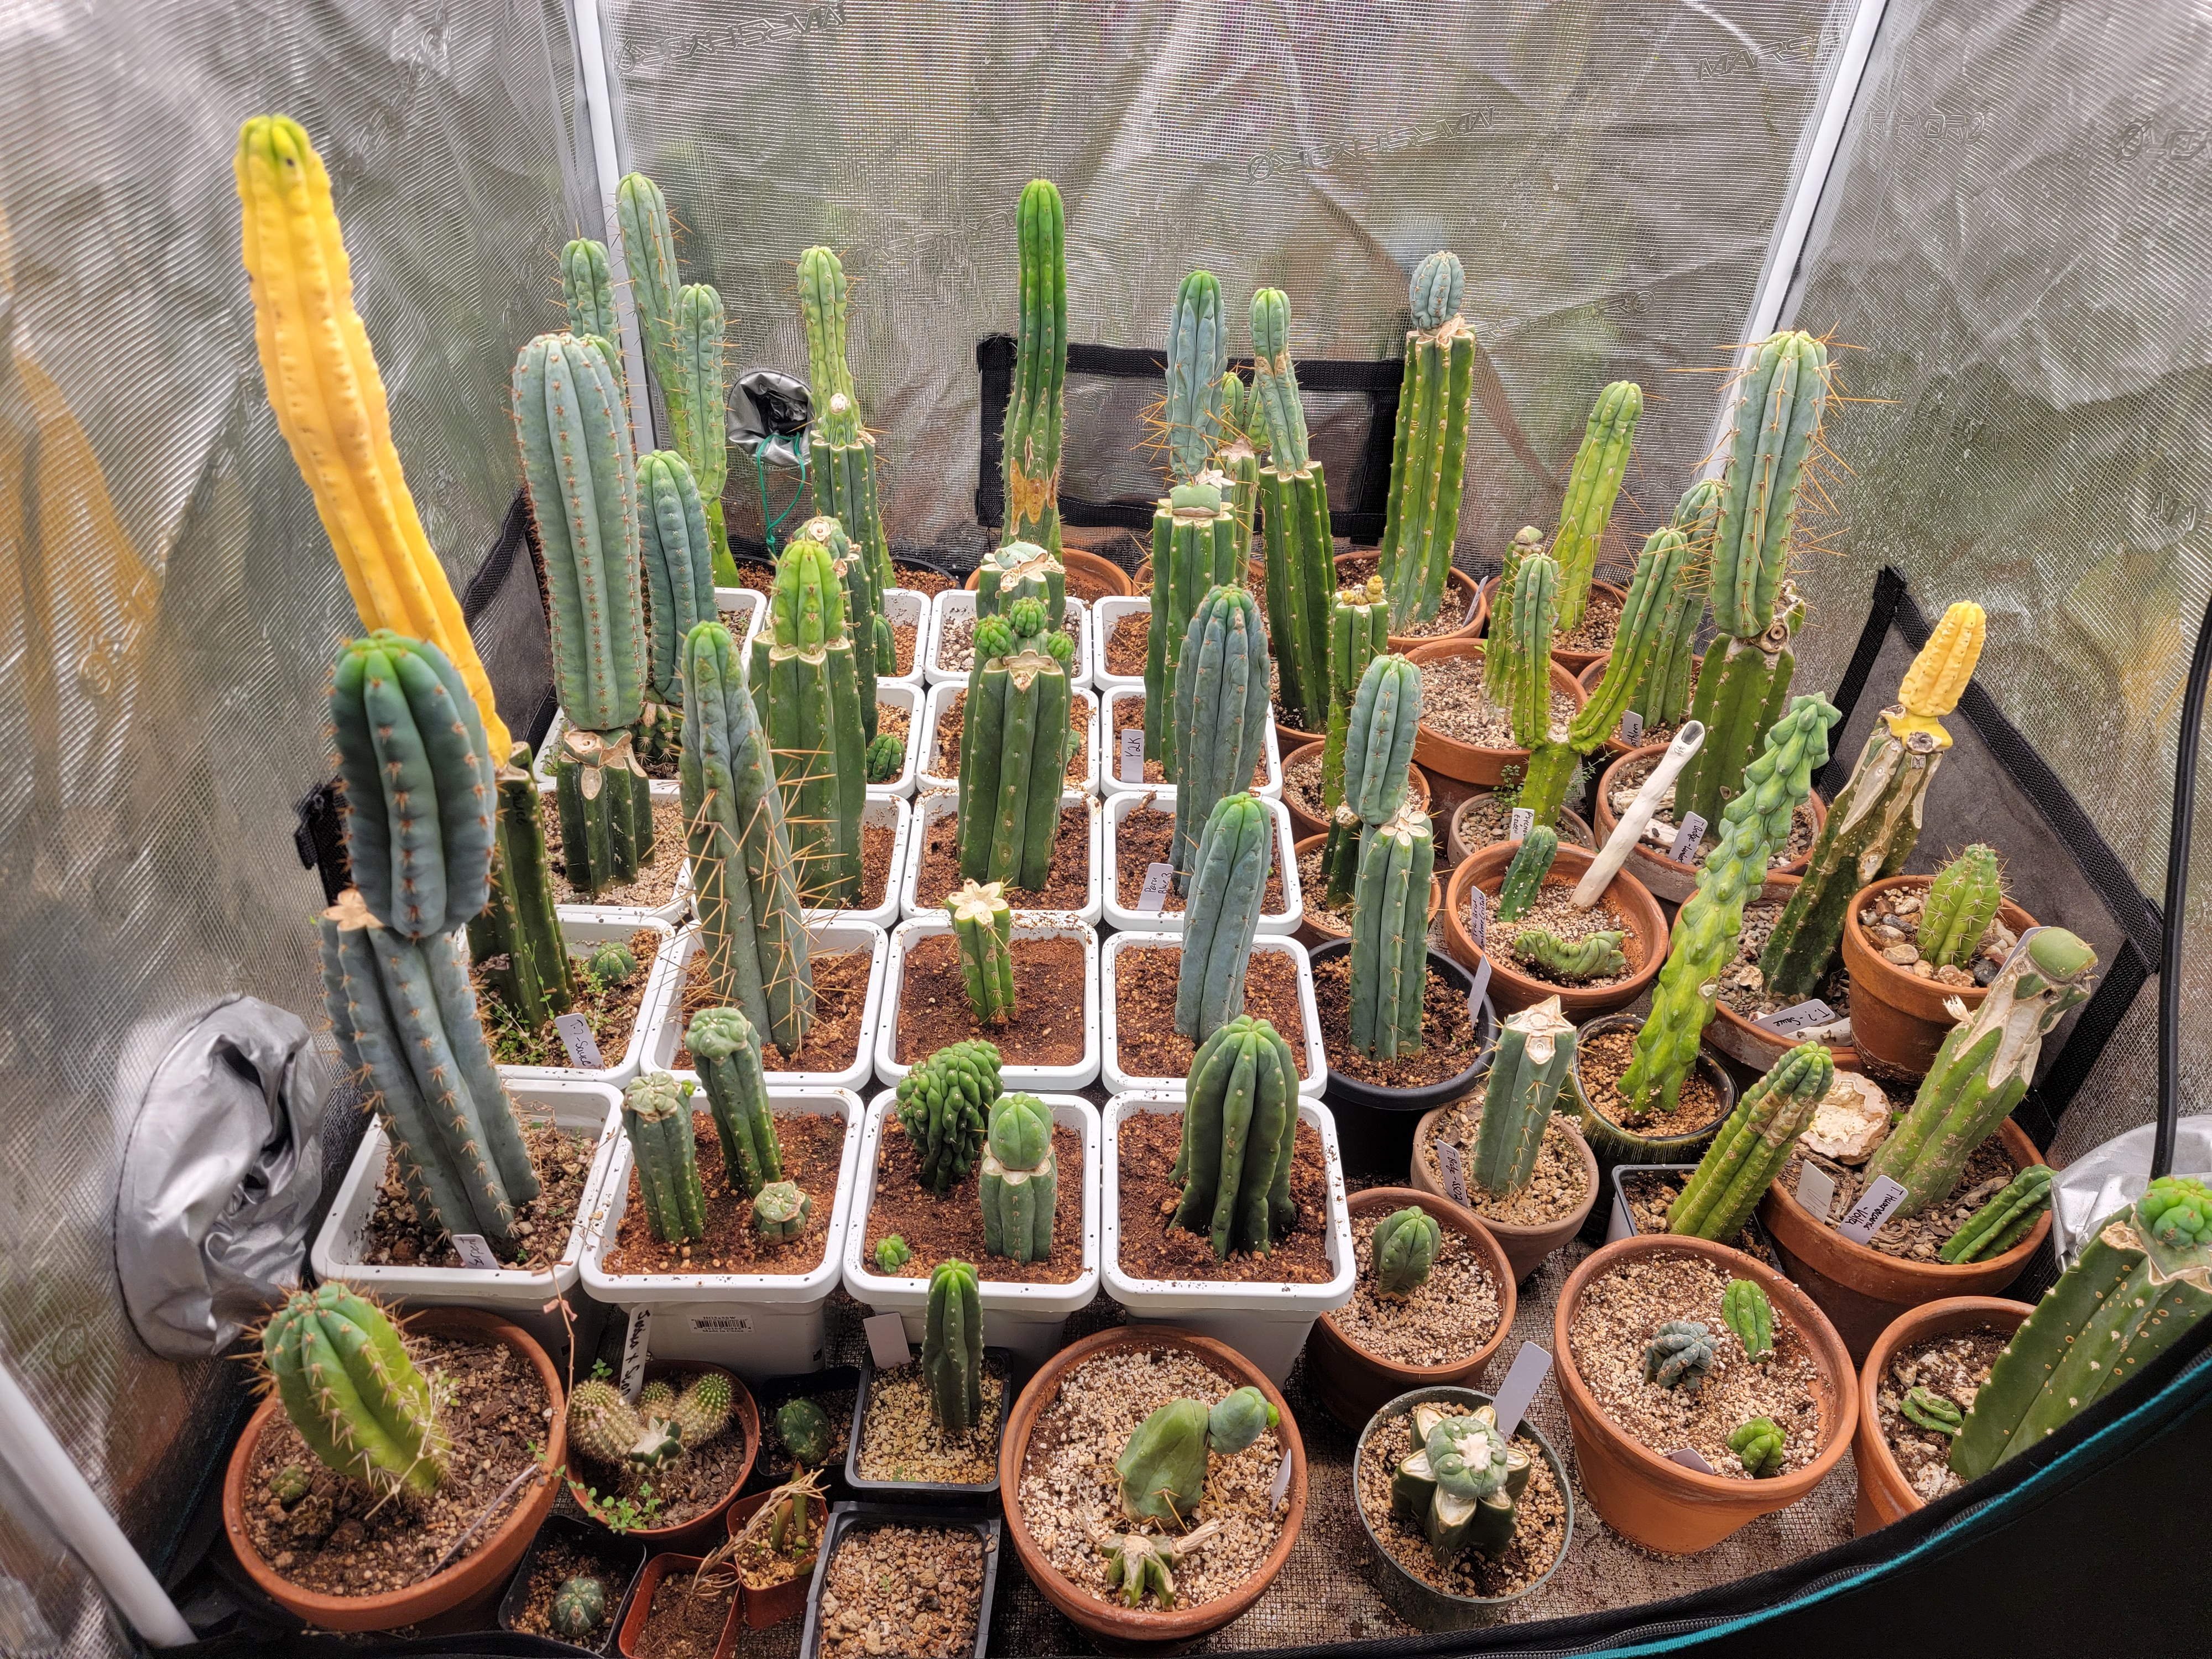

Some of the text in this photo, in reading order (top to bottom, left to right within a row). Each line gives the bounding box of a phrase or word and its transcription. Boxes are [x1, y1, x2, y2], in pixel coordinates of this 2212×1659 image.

[1627, 723, 1639, 747] athleen
[1124, 738, 1141, 757] Y2K
[1144, 877, 1157, 893] Peru
[1158, 880, 1169, 894] Blue
